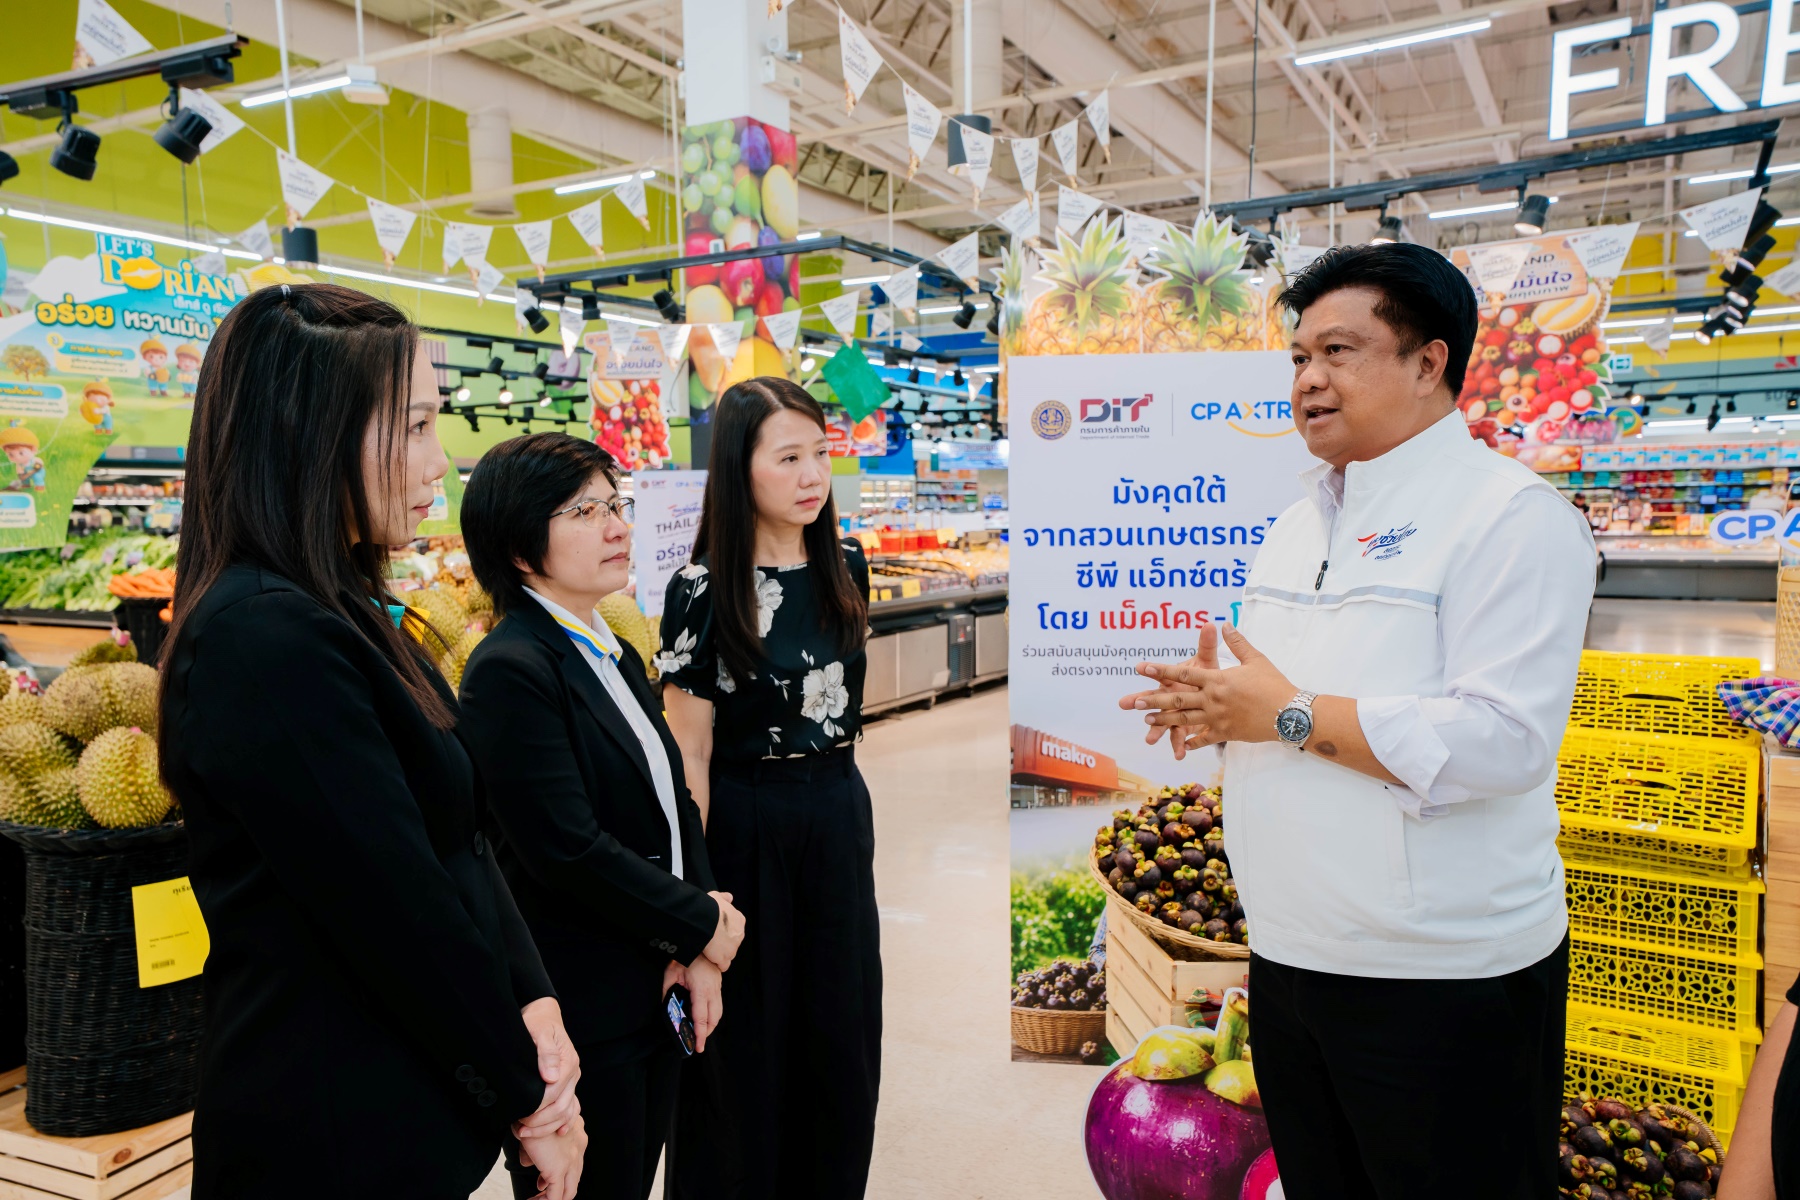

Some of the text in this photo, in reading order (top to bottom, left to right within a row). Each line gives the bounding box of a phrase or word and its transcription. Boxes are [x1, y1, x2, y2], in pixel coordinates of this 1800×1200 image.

[37, 294, 114, 327] อร่อย
[124, 310, 209, 340] หวานมัน
[1190, 402, 1222, 421] CP
[1080, 425, 1150, 434] กรมการค้าภายใน
[1112, 474, 1226, 513] มังคุดใต้
[1717, 514, 1777, 541] CP
[1076, 557, 1250, 588] ซีพี แอ็กซ์ตร้
[1037, 602, 1088, 630] โดย
[1022, 644, 1198, 662] ร่วมสนับสนุนมังคุดคุณภาพจ
[1041, 740, 1096, 769] makro
